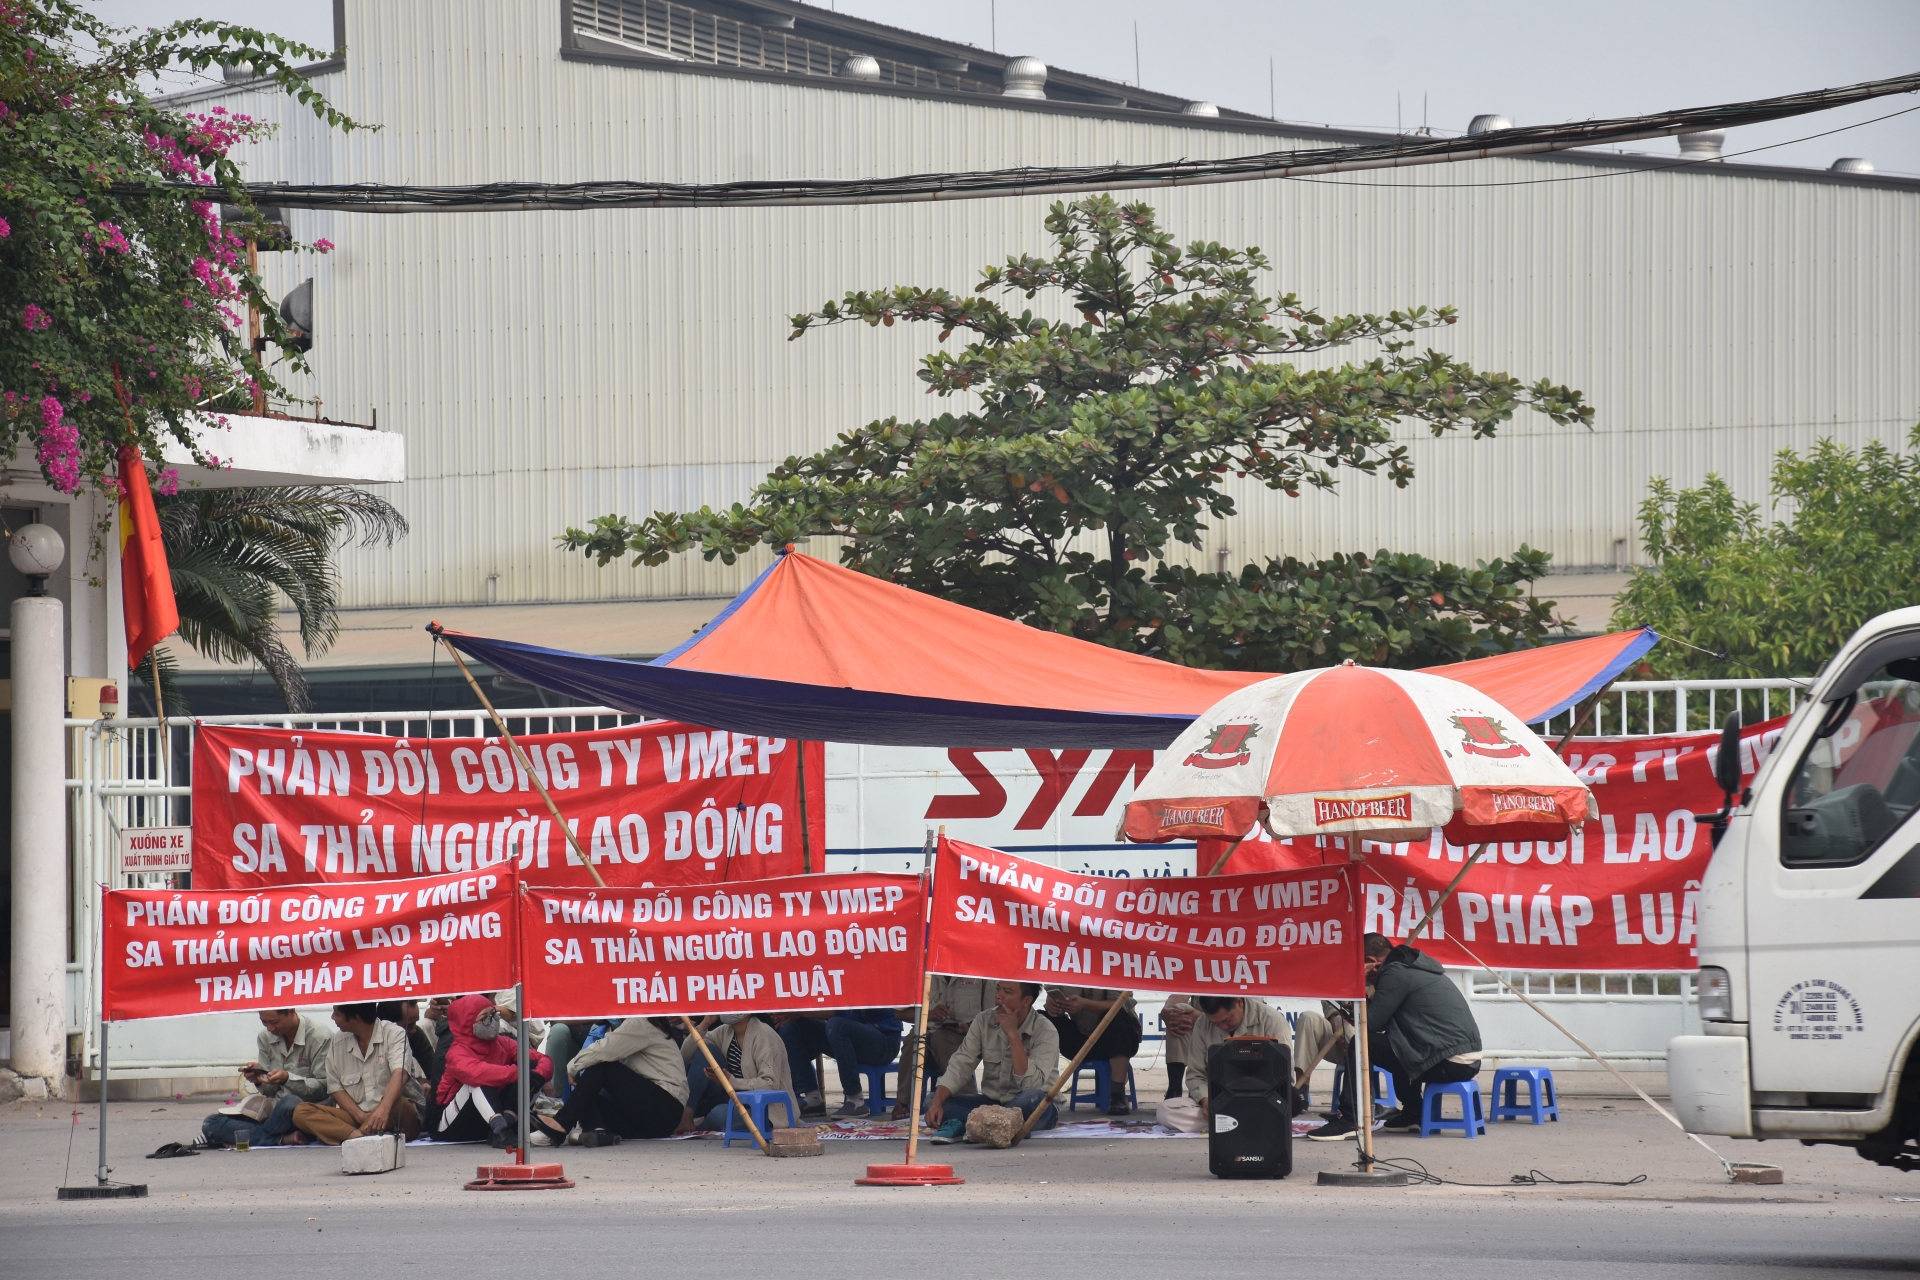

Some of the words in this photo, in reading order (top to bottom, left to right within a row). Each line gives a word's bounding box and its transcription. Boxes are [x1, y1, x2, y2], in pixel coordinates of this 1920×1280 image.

[228, 736, 350, 796] PHẢN
[451, 737, 580, 794] CÔNG
[588, 738, 642, 787] TY
[656, 730, 787, 784] VMEP
[1633, 746, 1694, 783] TY
[1161, 808, 1196, 827] HANOI
[1197, 807, 1225, 826] BEER
[1368, 797, 1408, 818] BEER
[1492, 793, 1526, 813] HANOI
[1528, 795, 1556, 813] BEER
[130, 831, 167, 850] XUỐNG
[170, 835, 184, 848] XE
[232, 822, 288, 873] SA
[300, 809, 397, 873] THẢI
[411, 809, 552, 873] NGƯỜI
[565, 813, 650, 866] LAO
[664, 798, 783, 871] ĐỘNG
[1602, 808, 1697, 863] LAO
[126, 893, 209, 927] PHẢN
[218, 893, 271, 924] ĐỐI
[280, 894, 365, 922] CÔNG
[375, 892, 409, 914] TY
[416, 875, 497, 908] VMEP
[542, 892, 624, 924] PHẢN
[632, 889, 683, 923] ĐỐI
[692, 889, 773, 921] CÔNG
[779, 891, 812, 917] TY
[821, 885, 903, 915] VMEP
[959, 854, 1044, 894] PHẢN
[1052, 881, 1106, 909] ĐỐI
[1115, 887, 1200, 916] CÔNG
[1210, 887, 1245, 913] TY
[1253, 878, 1340, 911] VMEP
[125, 940, 163, 968] SA
[172, 930, 239, 966] THẢI
[249, 926, 345, 961] NGƯỜI
[352, 924, 411, 950] LAO
[419, 912, 502, 947] ĐỘNG
[955, 895, 996, 925] SA
[1004, 900, 1070, 933] THẢI
[1079, 921, 1178, 942] NGƯỜI
[1187, 926, 1246, 948] LAO
[1255, 917, 1343, 951] ĐỘNG
[1360, 877, 1445, 940] RÁI
[1457, 884, 1594, 946] PHÁP
[1612, 879, 1699, 957] LUẬ
[544, 938, 584, 965] SA
[590, 928, 656, 964] THẢI
[663, 926, 754, 961] NGƯỜI
[762, 929, 817, 958] LAO
[824, 922, 907, 960] ĐỘNG
[1023, 941, 1092, 975] TRÁI
[1102, 950, 1184, 982] PHÁP
[1194, 954, 1271, 990] LUẬT
[195, 969, 263, 1003] TRÁI
[273, 961, 354, 997] PHÁP
[363, 953, 435, 992] LUẬT
[611, 971, 678, 1004] TRÁI
[686, 968, 765, 1002] PHÁP
[773, 964, 845, 1003] LUẬT
